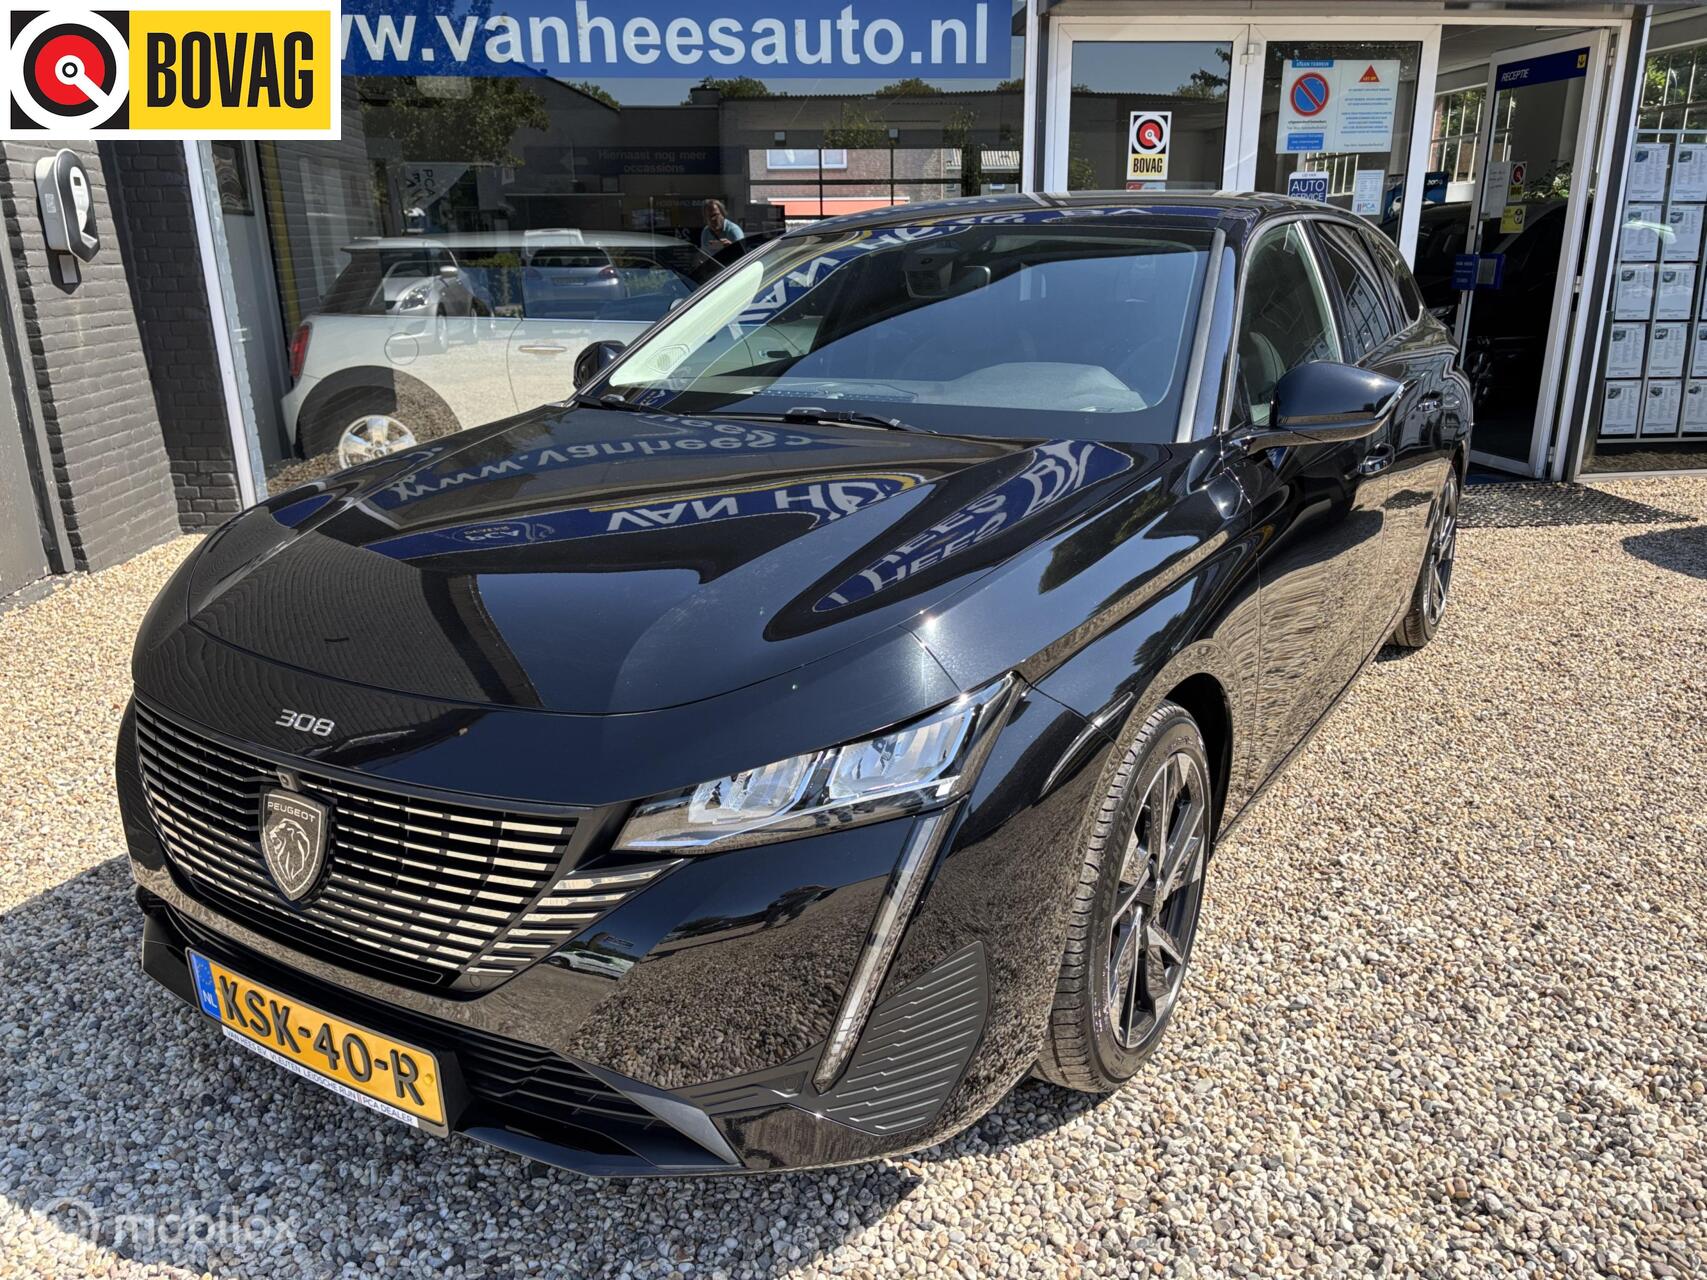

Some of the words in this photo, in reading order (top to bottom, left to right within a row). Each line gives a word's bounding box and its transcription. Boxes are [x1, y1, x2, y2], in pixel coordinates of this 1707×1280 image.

[1501, 68, 1530, 82] RECEPTIE
[1133, 157, 1163, 174] BOVAG
[1291, 180, 1325, 192] AUTO
[275, 708, 335, 737] 308
[267, 801, 316, 823] PEUGEOT
[202, 990, 218, 1008] NL
[219, 975, 425, 1107] KSK-40-R
[226, 1029, 240, 1042] VAN
[239, 1035, 257, 1050] HEES
[303, 1069, 339, 1092] LEIDSCHE
[339, 1085, 357, 1099] RIJN
[363, 1095, 379, 1111] PCA
[380, 1104, 413, 1124] DEALER
